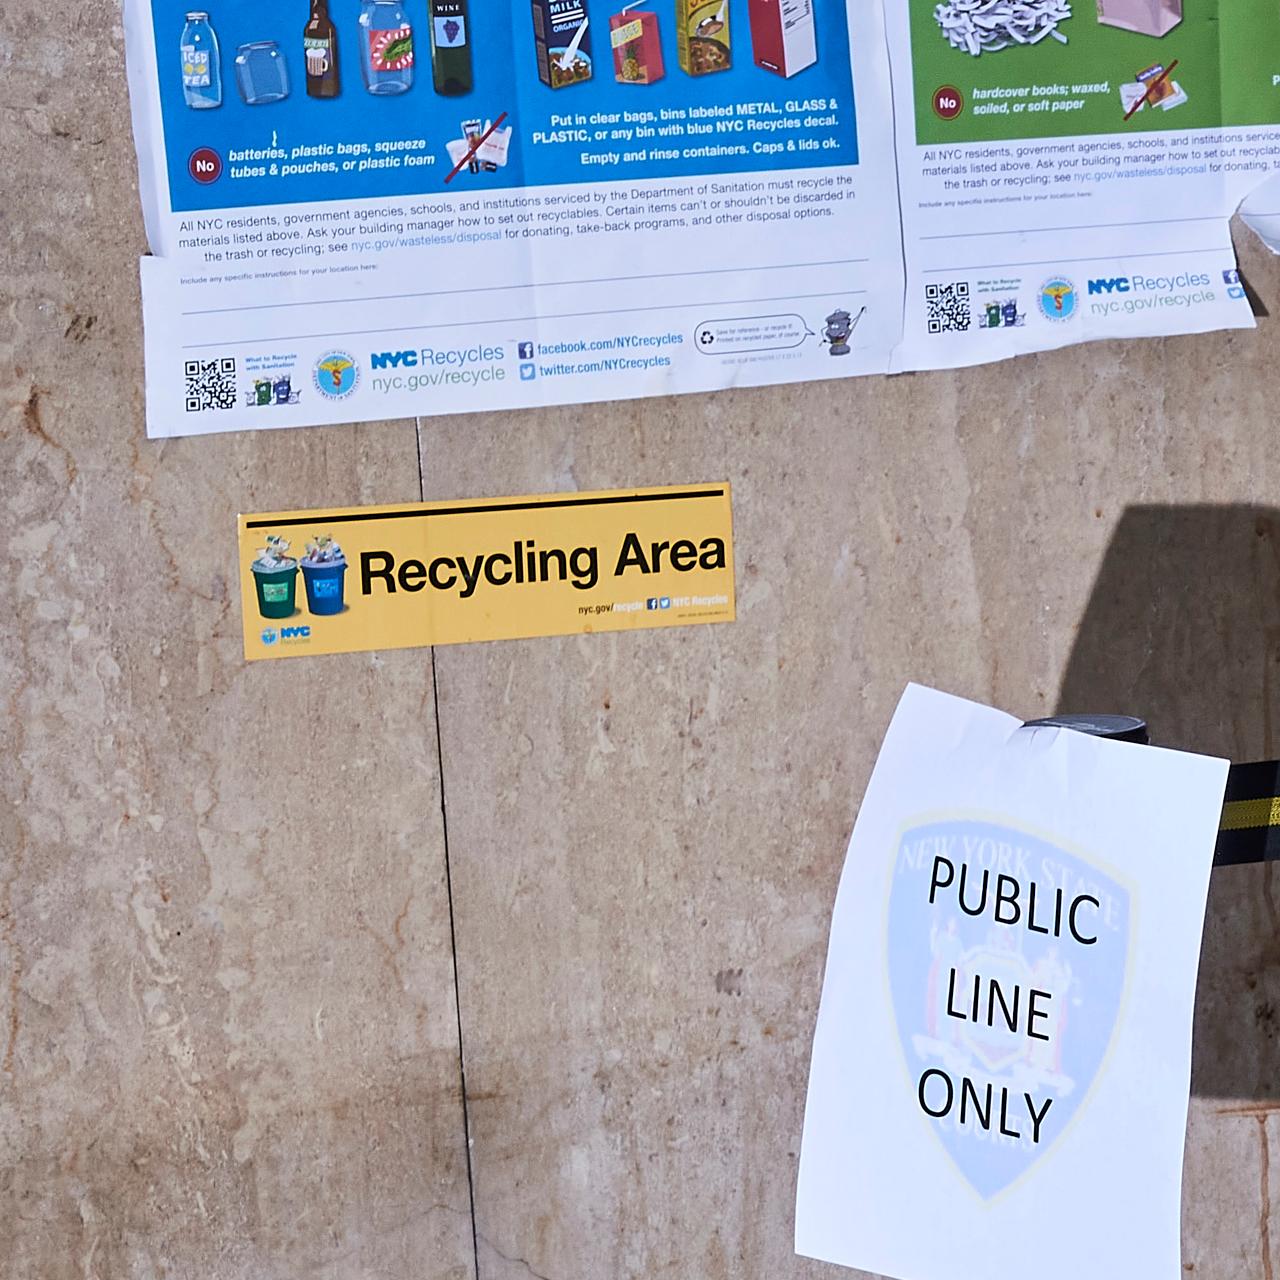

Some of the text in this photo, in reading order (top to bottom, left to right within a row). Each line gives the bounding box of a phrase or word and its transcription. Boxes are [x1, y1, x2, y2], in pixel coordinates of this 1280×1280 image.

[550, 0, 582, 13] MILK
[184, 51, 207, 63] ICED
[184, 75, 210, 85] TEA
[972, 81, 1110, 98] hardcover books; waxed,
[550, 98, 837, 126] Put in clear bags, bins labeled METAL, GLASS &
[940, 97, 956, 109] No
[973, 100, 1085, 114] soiled, or soft paper
[532, 114, 838, 143] PLASTIC, or any bin with blue NYC Recycles decal.
[228, 140, 425, 160] batteries, plastic bags, squeeze
[580, 137, 840, 164] Empty and rinse containers. Caps & lids ok.
[196, 160, 214, 172] No
[230, 154, 434, 177] tubes & pouches, or plastic foam
[179, 175, 852, 231] All NYC residents, government agencies, schools, and institutions serviced by the Department of Sanitation must recycle the
[178, 235, 230, 247] materials
[232, 231, 262, 243] listed
[266, 230, 302, 241] above.
[306, 227, 328, 237] Ask
[330, 226, 355, 238] your
[358, 222, 403, 233] building
[406, 220, 454, 230] manager
[457, 217, 480, 226] how
[483, 216, 494, 224] to
[498, 214, 513, 226] set
[516, 212, 533, 222] out
[537, 208, 602, 221] recyclables.
[604, 205, 644, 216] Certain
[648, 204, 676, 212] items
[680, 200, 706, 210] can't
[710, 200, 720, 208] or
[724, 195, 773, 207] shouldn't
[776, 195, 790, 204] be
[793, 190, 843, 202] discarded
[204, 208, 833, 261] the trash or recycling; see nyc.gov/wasteless/disposal for donating, take-back programs, and other disposal options.
[1088, 272, 1210, 295] NYC Recycles
[1091, 291, 1215, 316] nyc.gov/recycle
[537, 334, 683, 353] facebook.com/NYCrecycles
[371, 344, 505, 370] NYC Recycles
[539, 357, 670, 375] twitter.com/NYCrecycles
[372, 366, 505, 393] nyc.gov/recycle
[360, 532, 727, 598] Recycling Area
[281, 626, 311, 638] NYC
[929, 856, 1100, 945] PUBLIC
[948, 968, 1052, 1041] LINE
[919, 1069, 1053, 1144] ONLY
